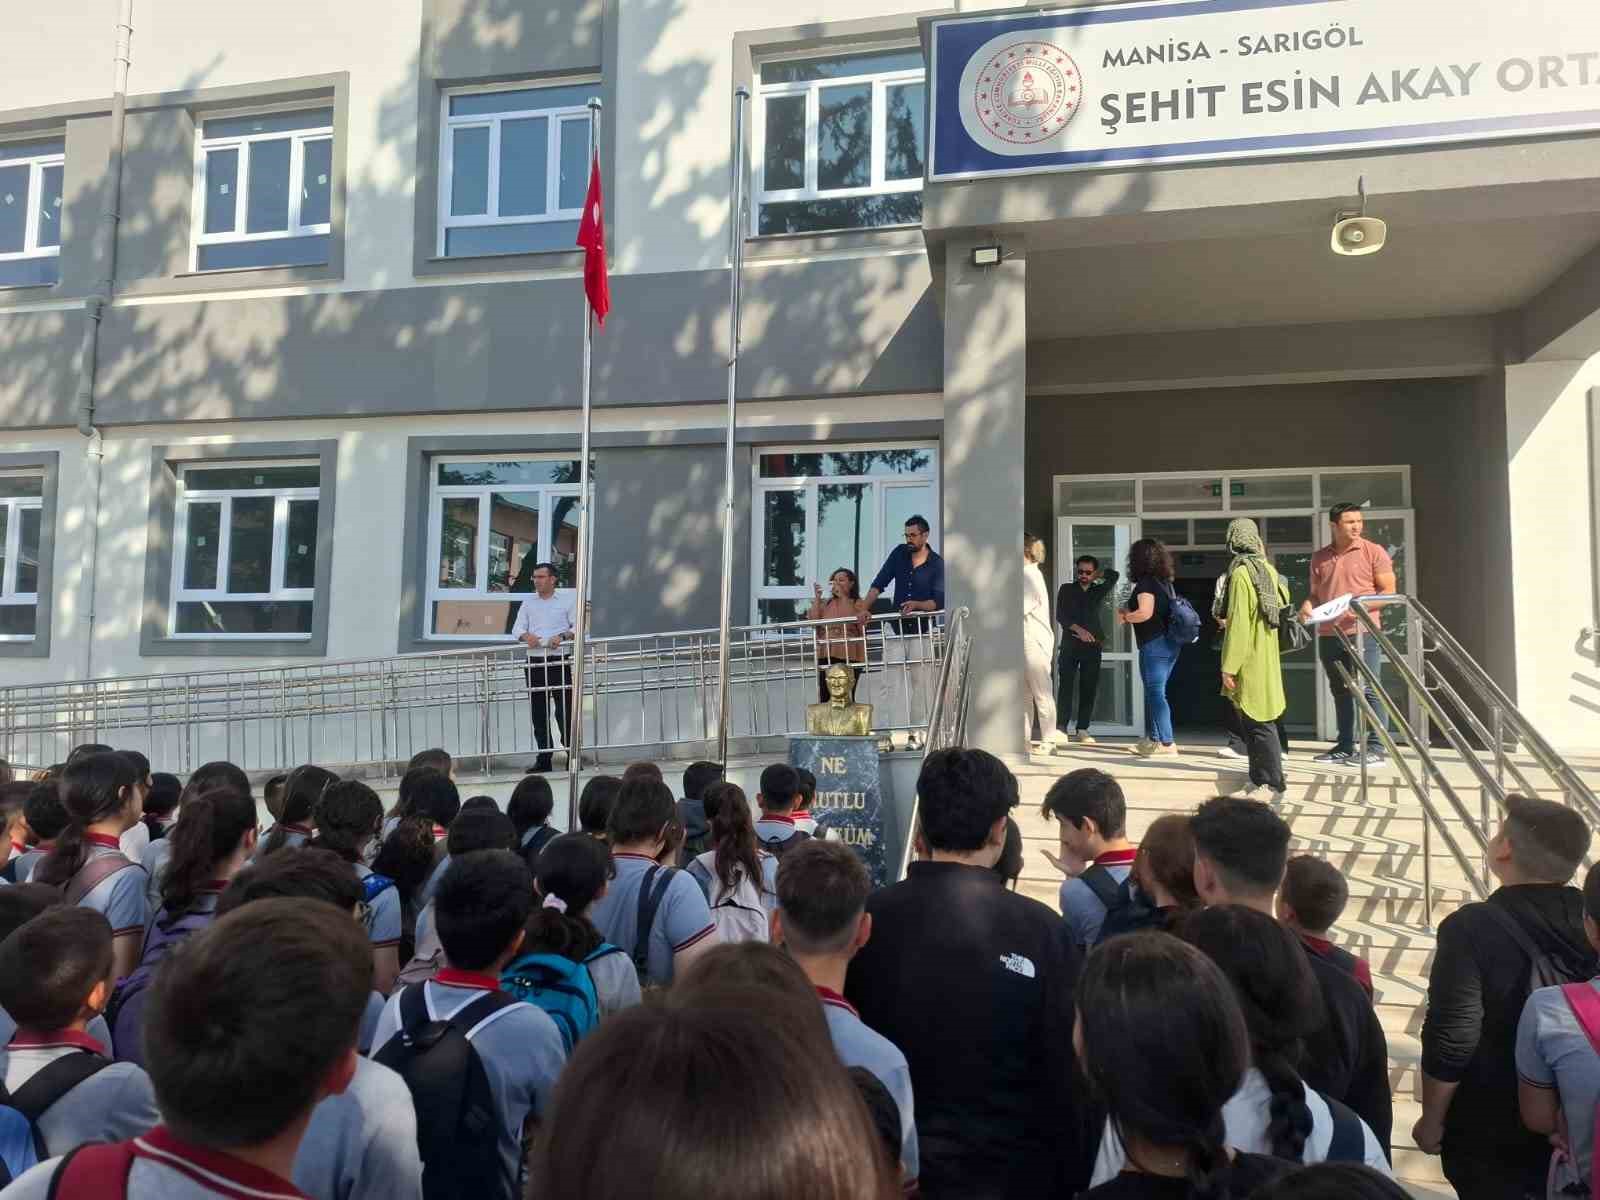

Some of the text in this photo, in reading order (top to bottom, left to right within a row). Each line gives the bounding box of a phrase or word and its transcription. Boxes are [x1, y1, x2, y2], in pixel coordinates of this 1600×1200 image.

[1102, 38, 1211, 68] MANİSA
[1238, 23, 1363, 56] SARIGÖL
[1100, 79, 1226, 135] ŞEHİT
[1242, 70, 1340, 114] ESİN
[1356, 63, 1482, 105] AKAY
[1496, 52, 1600, 93] ORT
[820, 757, 847, 774] NE
[813, 791, 865, 809] UTLU
